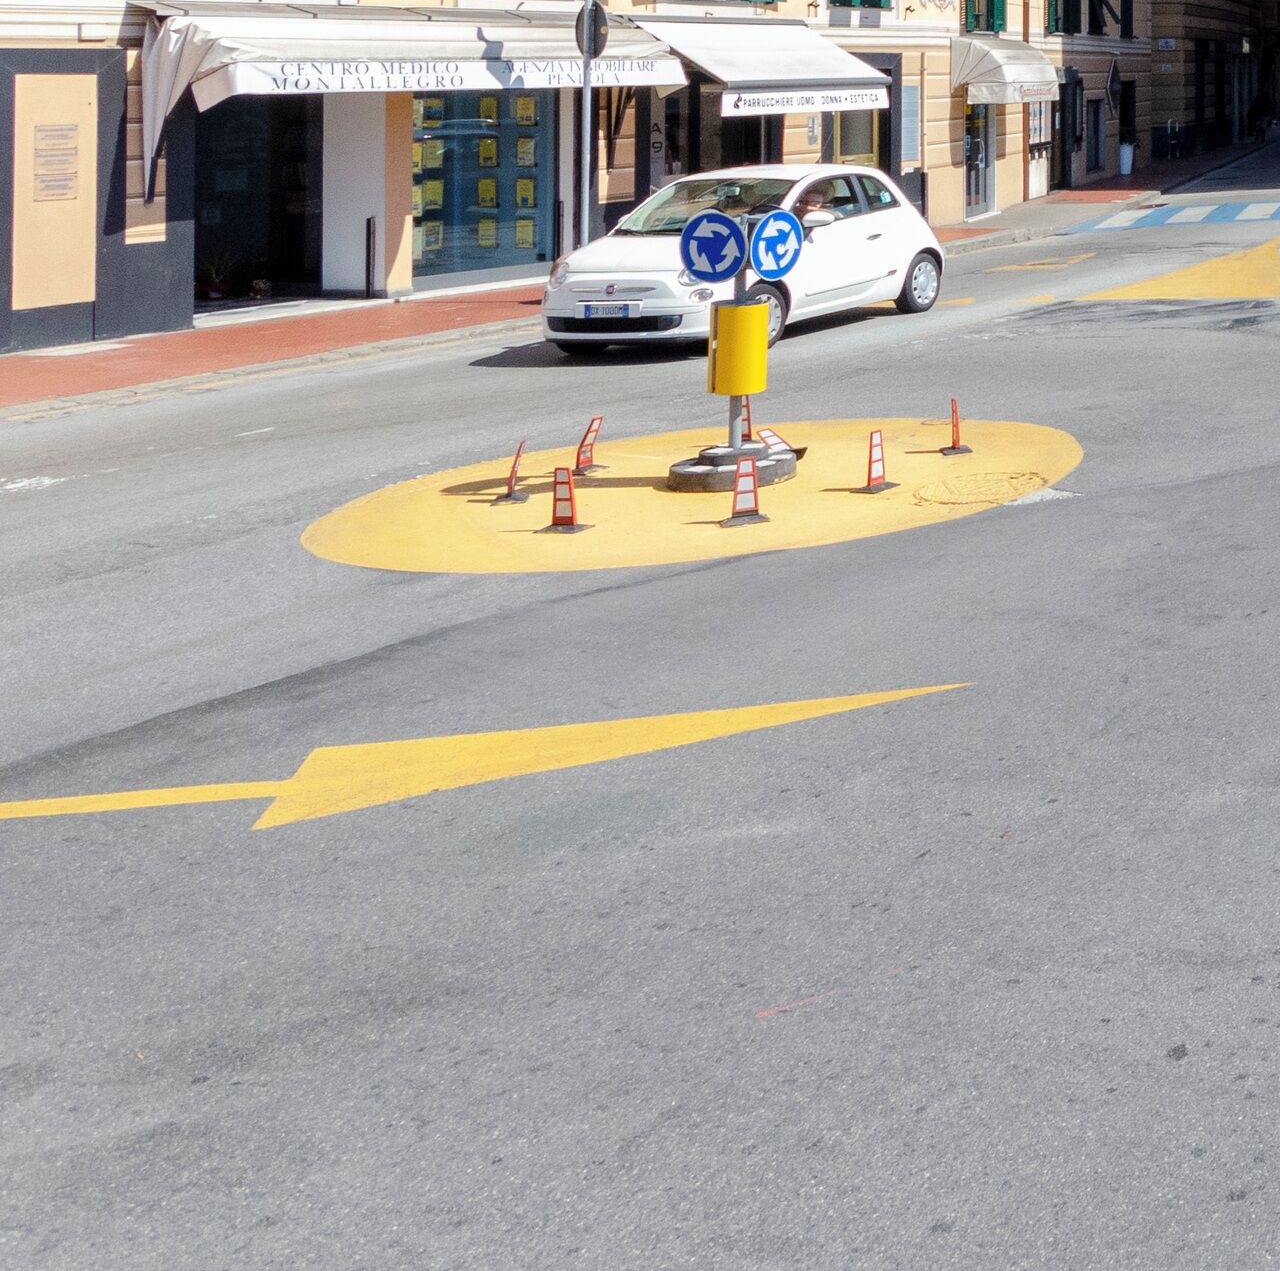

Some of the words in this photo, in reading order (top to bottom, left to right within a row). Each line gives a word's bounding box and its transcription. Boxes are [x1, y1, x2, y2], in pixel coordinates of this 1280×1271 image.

[280, 63, 369, 76] CENTRO
[380, 62, 459, 75] MEDICO
[502, 61, 564, 74] AGENZIA
[271, 75, 464, 91] MONTALLEGRO
[743, 97, 794, 108] PARRUCCHIERE
[796, 96, 815, 106] UOMO
[820, 95, 842, 105] DONNA
[849, 93, 879, 104] ESTETICA
